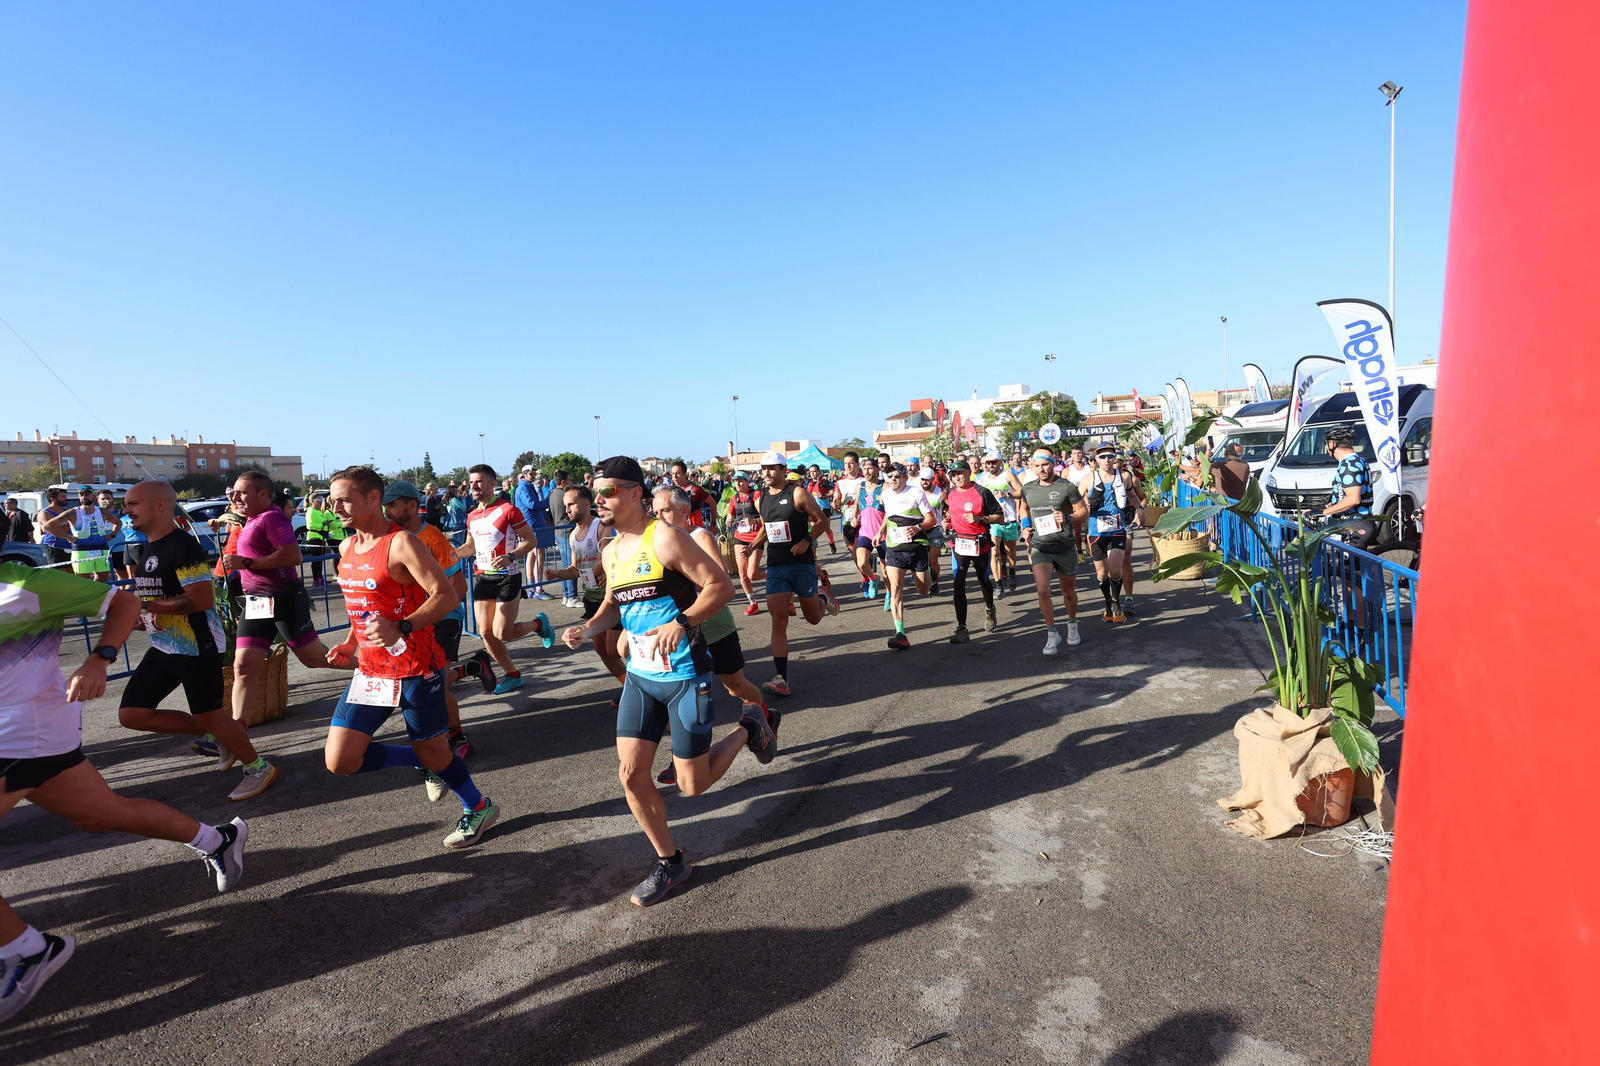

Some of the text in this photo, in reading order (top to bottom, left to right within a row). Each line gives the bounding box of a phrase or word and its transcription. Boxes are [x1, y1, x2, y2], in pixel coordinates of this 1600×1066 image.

[1066, 426, 1119, 437] TRAIL PIRATA
[365, 681, 382, 693] 54
